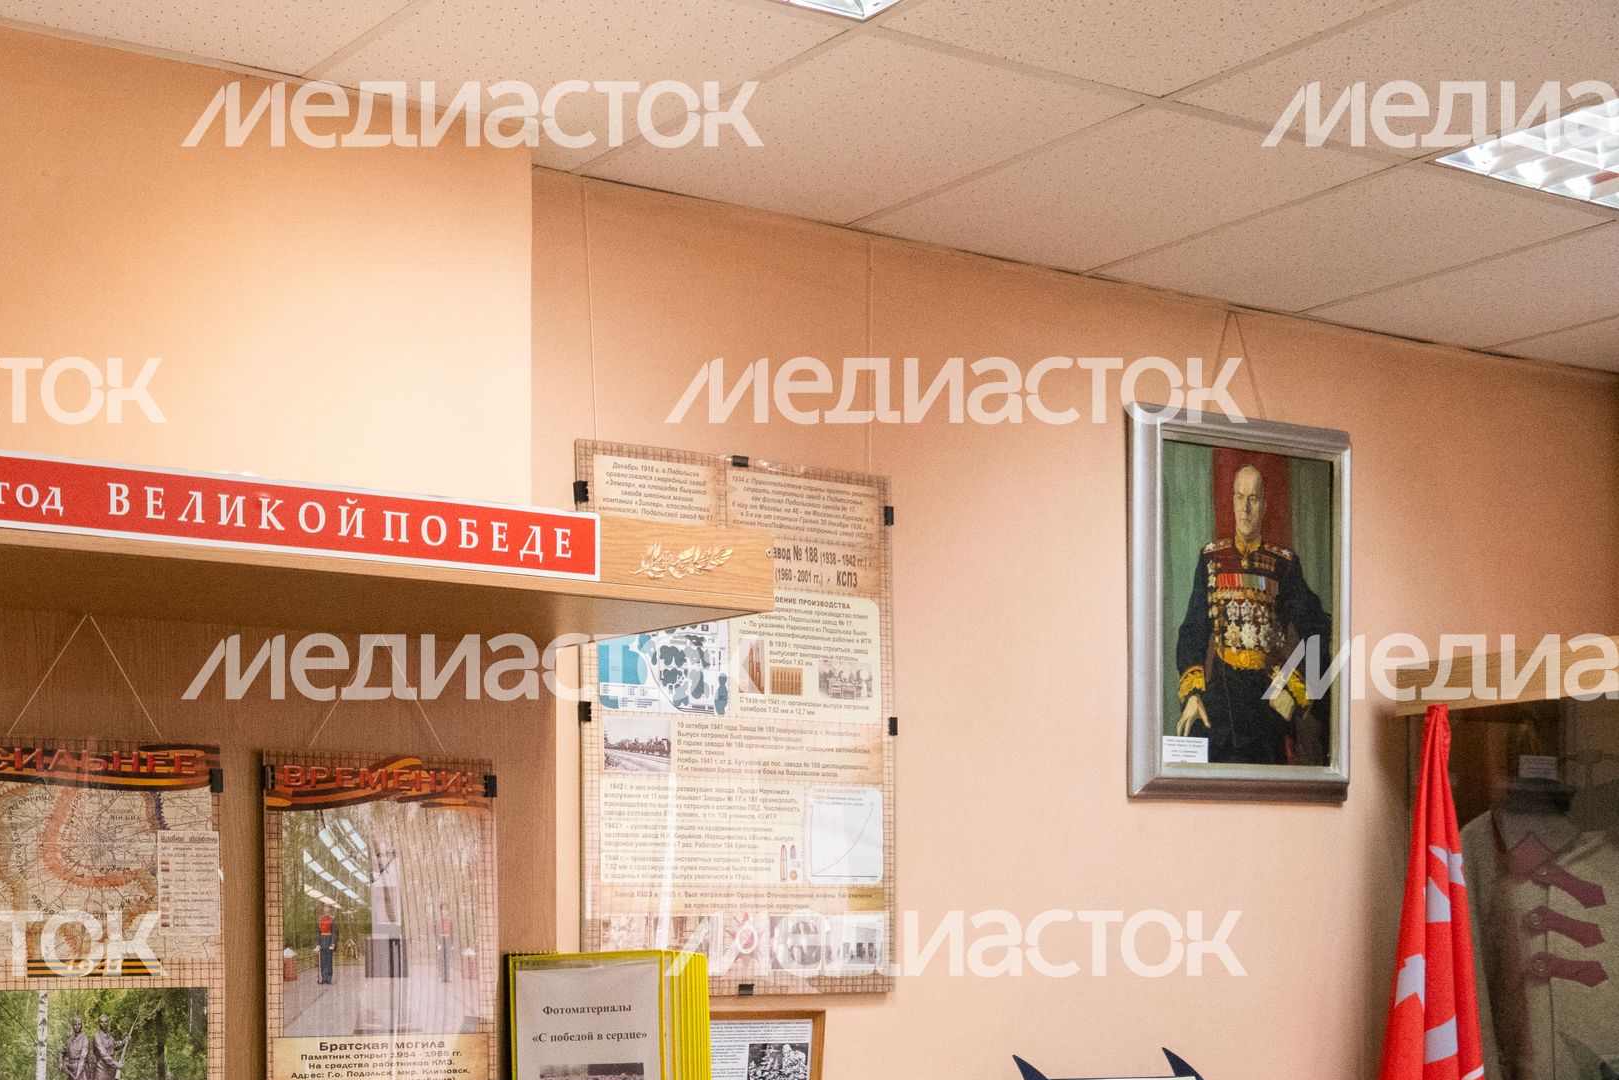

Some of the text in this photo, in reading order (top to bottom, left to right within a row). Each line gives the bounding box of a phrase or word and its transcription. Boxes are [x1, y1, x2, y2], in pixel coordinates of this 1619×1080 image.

[107, 482, 364, 538] ВЕЛИКОЙ
[382, 510, 572, 563] ПОБЕДЕ
[542, 1003, 631, 1016] Фотоматериалы
[532, 1031, 647, 1043] «С победой в сердце»
[318, 1040, 444, 1053] Братская могила
